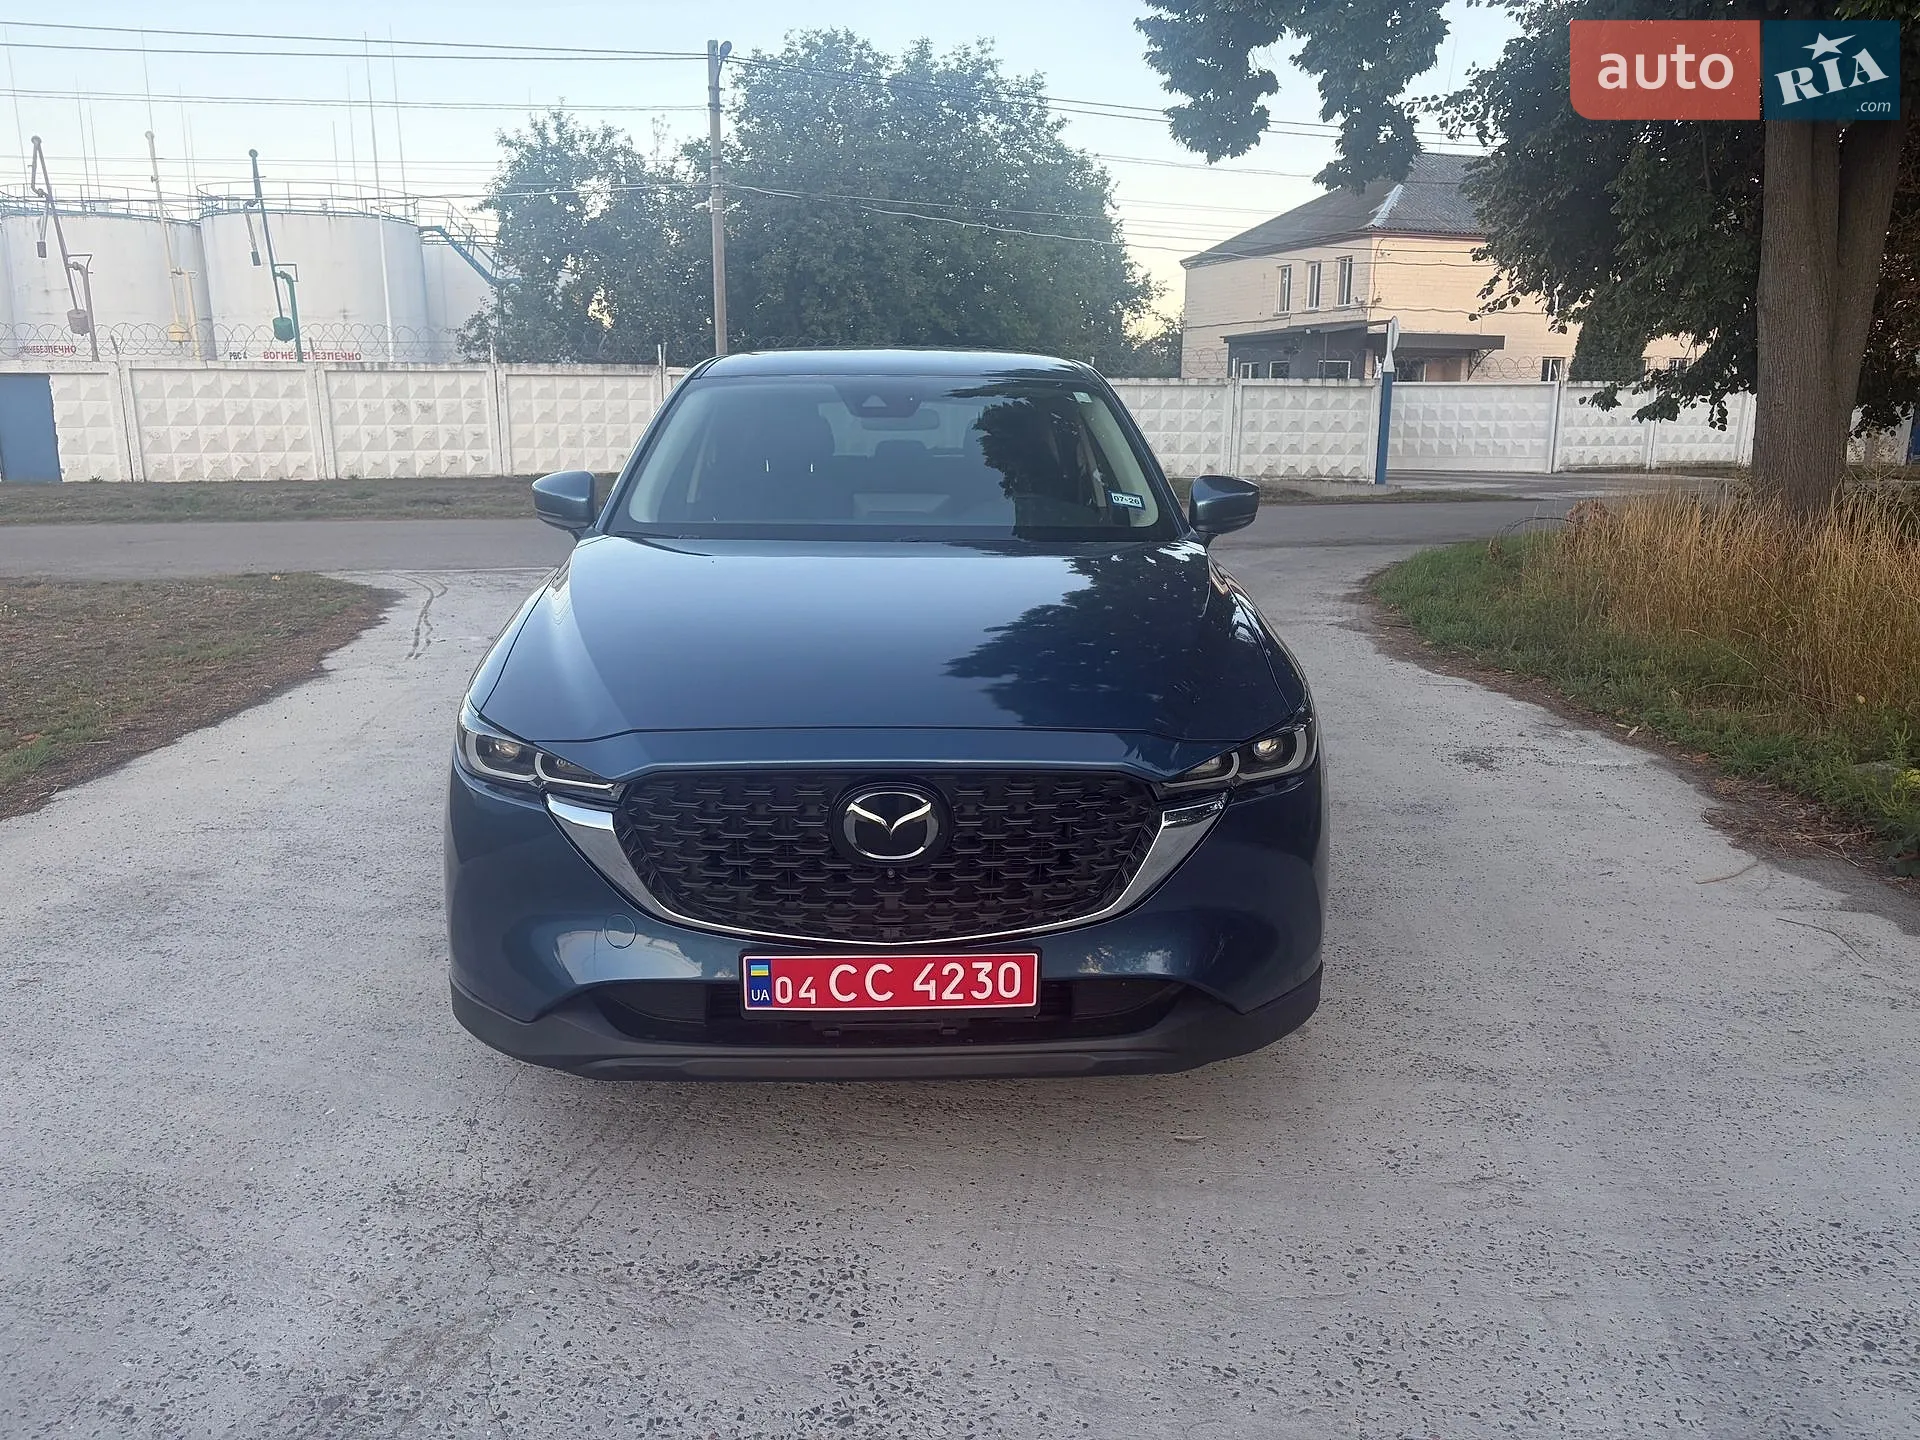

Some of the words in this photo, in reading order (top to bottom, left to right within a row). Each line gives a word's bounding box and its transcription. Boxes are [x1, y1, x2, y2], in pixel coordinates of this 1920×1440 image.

[19, 345, 77, 354] НЕБЕЗПЕЧНО
[774, 976, 817, 1005] 04
[828, 963, 894, 1002] CC
[913, 961, 1022, 1001] 4230
[751, 989, 770, 1001] UA
